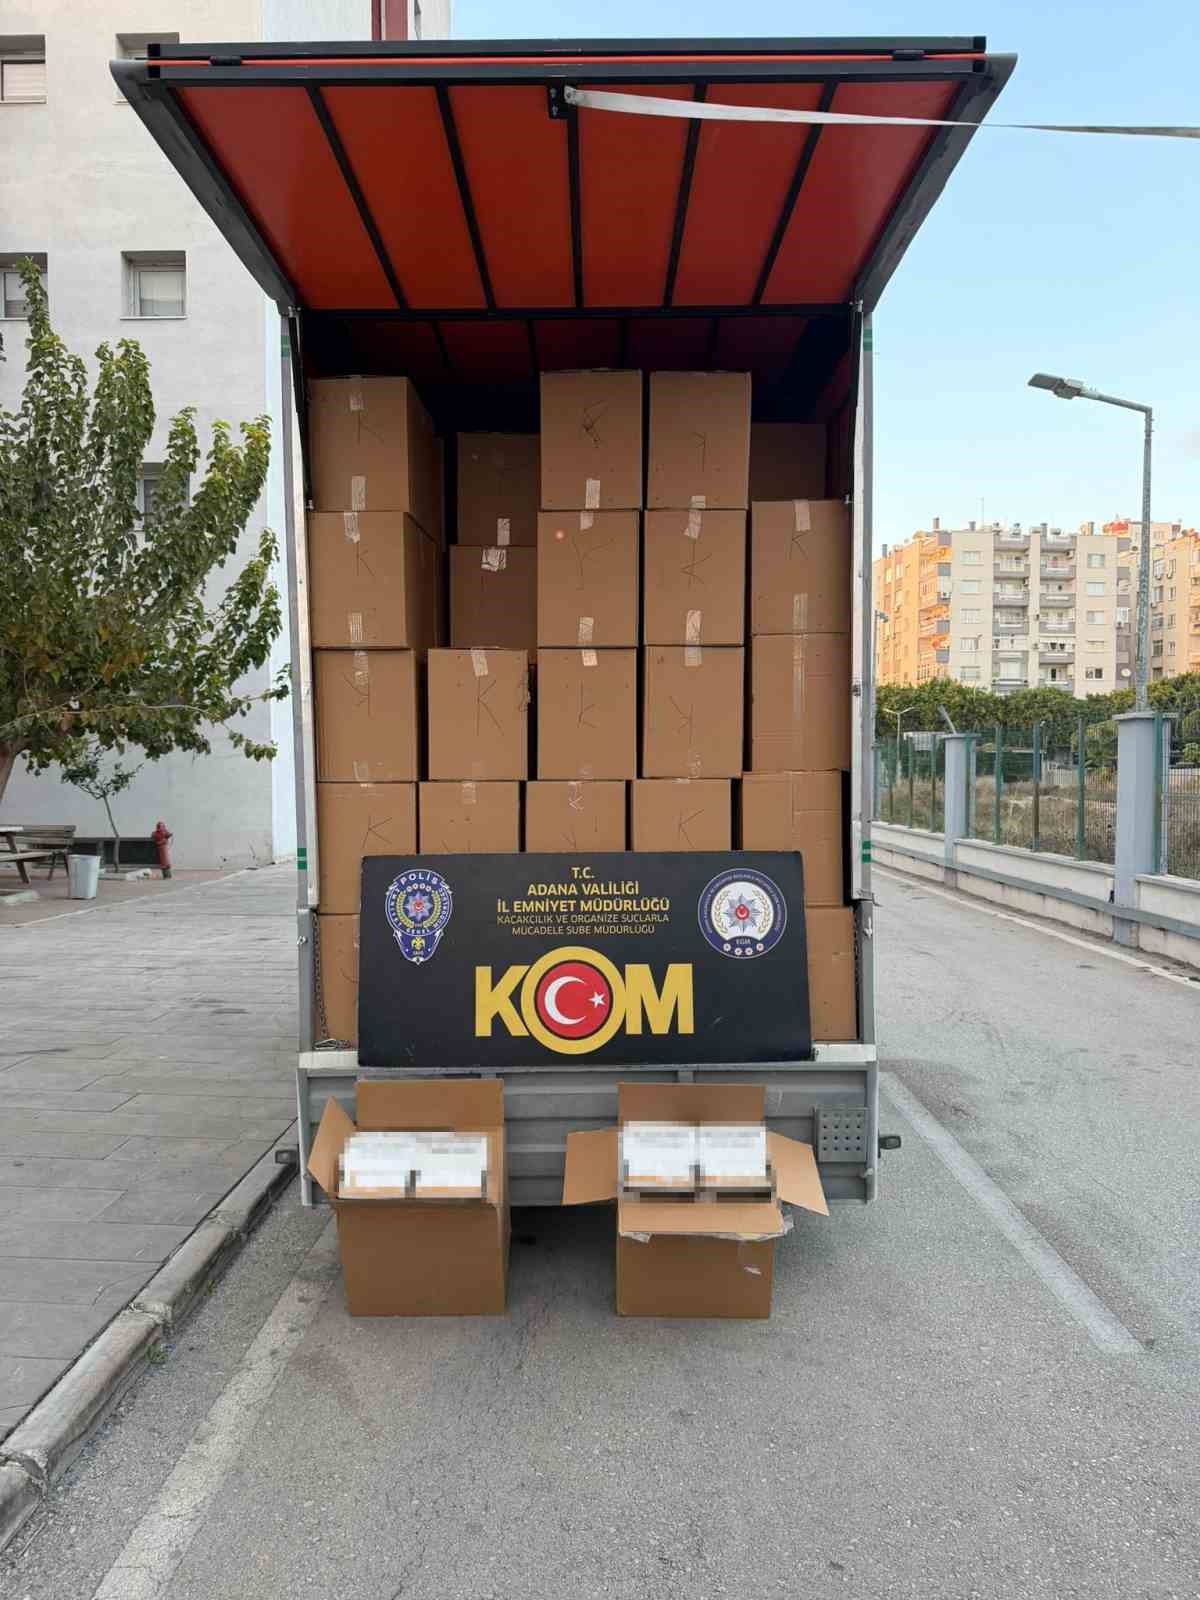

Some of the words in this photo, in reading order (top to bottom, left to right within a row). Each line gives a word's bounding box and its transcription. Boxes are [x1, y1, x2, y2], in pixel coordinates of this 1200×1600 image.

[571, 866, 595, 879] T.C.
[527, 883, 578, 896] ADANA
[497, 898, 510, 913] İL
[513, 898, 576, 913] EMNİYET
[580, 897, 670, 912] MÜDÜRLÜĞÜ
[556, 914, 569, 924] VE
[475, 946, 694, 1055] KOM
